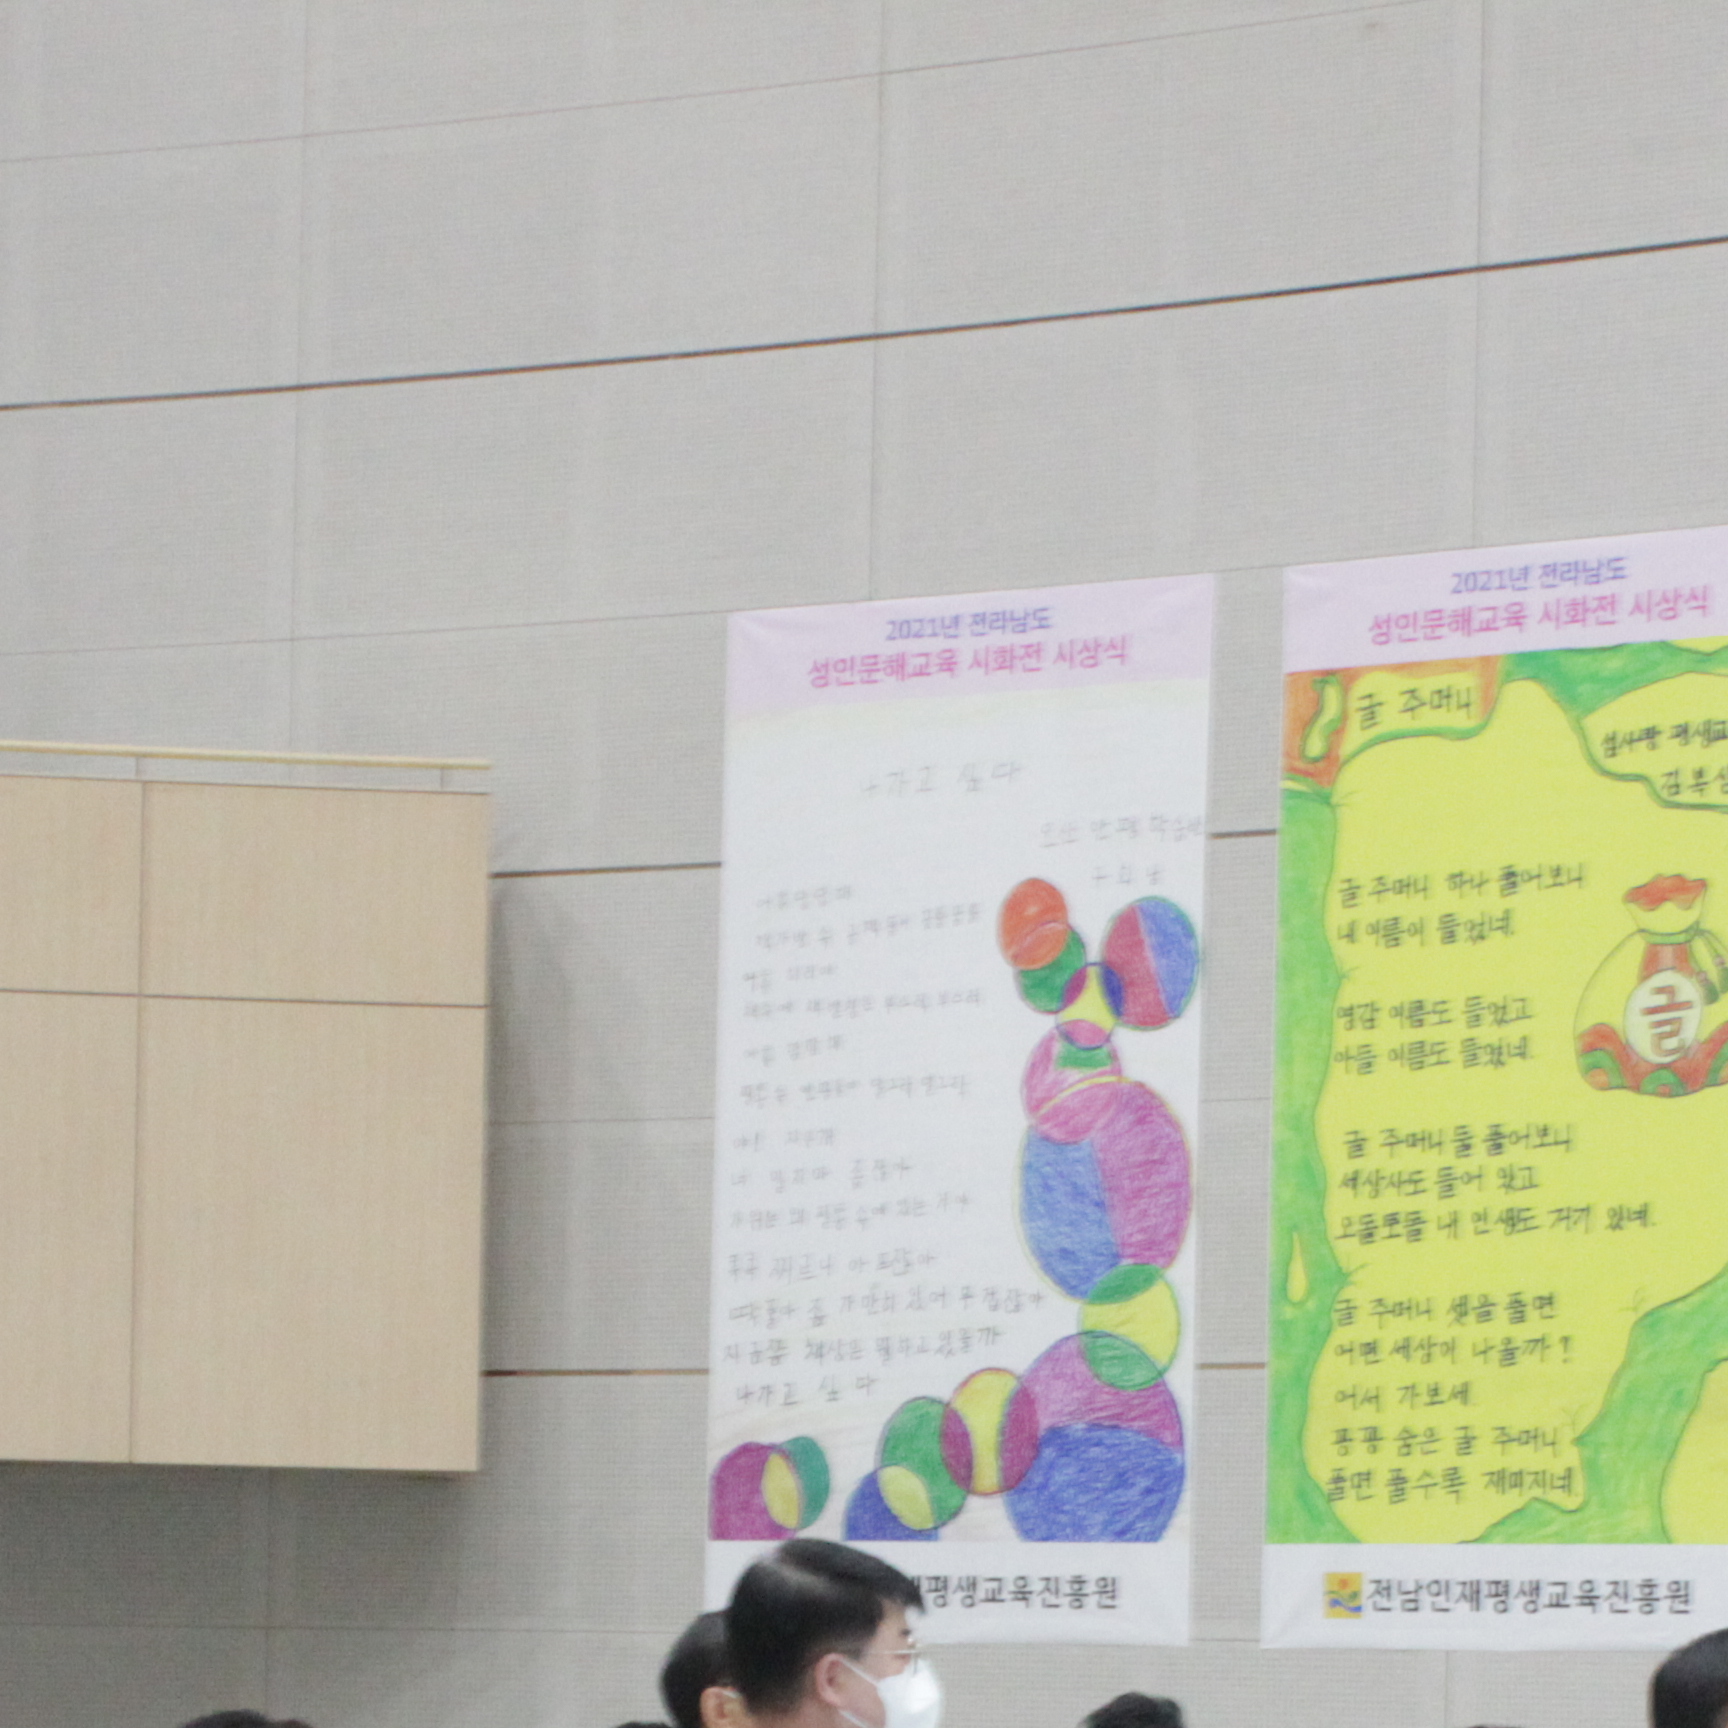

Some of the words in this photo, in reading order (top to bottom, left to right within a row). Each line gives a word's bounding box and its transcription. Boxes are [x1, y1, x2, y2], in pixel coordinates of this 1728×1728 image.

[1451, 566, 1530, 594] 2021년
[1538, 557, 1628, 588] 전라남도
[885, 614, 962, 640] 2021년
[968, 607, 1053, 636] 전라남도
[1368, 601, 1527, 645] 성인문해교육
[1538, 593, 1616, 630] 시화전
[1629, 584, 1712, 621] 시상식
[807, 649, 958, 688] 성인문해교육
[968, 642, 1043, 675] 시화전
[1052, 634, 1131, 668] 시상식
[1356, 693, 1385, 731] 글
[1399, 685, 1473, 719] 주머니
[1338, 877, 1362, 908] 글
[1368, 874, 1429, 901] 주머니
[1446, 869, 1490, 899] 하나
[1497, 862, 1587, 898] 풀어보니
[1337, 919, 1358, 944] 내
[1366, 915, 1426, 949] 이름이
[1389, 999, 1454, 1029] 이름도
[1462, 995, 1536, 1029] 들었고
[1643, 984, 1694, 1058] 글
[1334, 1043, 1378, 1076] 아들
[1388, 1039, 1452, 1072] 이름도
[1343, 1129, 1369, 1159] 글
[1379, 1128, 1445, 1158] 주머니
[1482, 1122, 1575, 1157] 풀어보니
[1435, 1165, 1483, 1200] 들어
[1496, 1163, 1540, 1194] 있고
[1437, 1210, 1460, 1240] 내
[1471, 1206, 1542, 1237] 인생도
[1547, 1204, 1593, 1234] 거기
[1333, 1297, 1358, 1327] 글
[1368, 1296, 1434, 1330] 주머니
[1504, 1291, 1557, 1326] 풀면
[1389, 1335, 1458, 1365] 세상이
[1334, 1383, 1382, 1414] 어서
[1393, 1425, 1442, 1457] 숨은
[1454, 1425, 1478, 1456] 글
[1491, 1425, 1559, 1458] 주머니
[1326, 1467, 1376, 1504] 풀면
[1386, 1466, 1469, 1506] 풀수록
[1367, 1578, 1692, 1615] 전남인재평생교육진흥원
